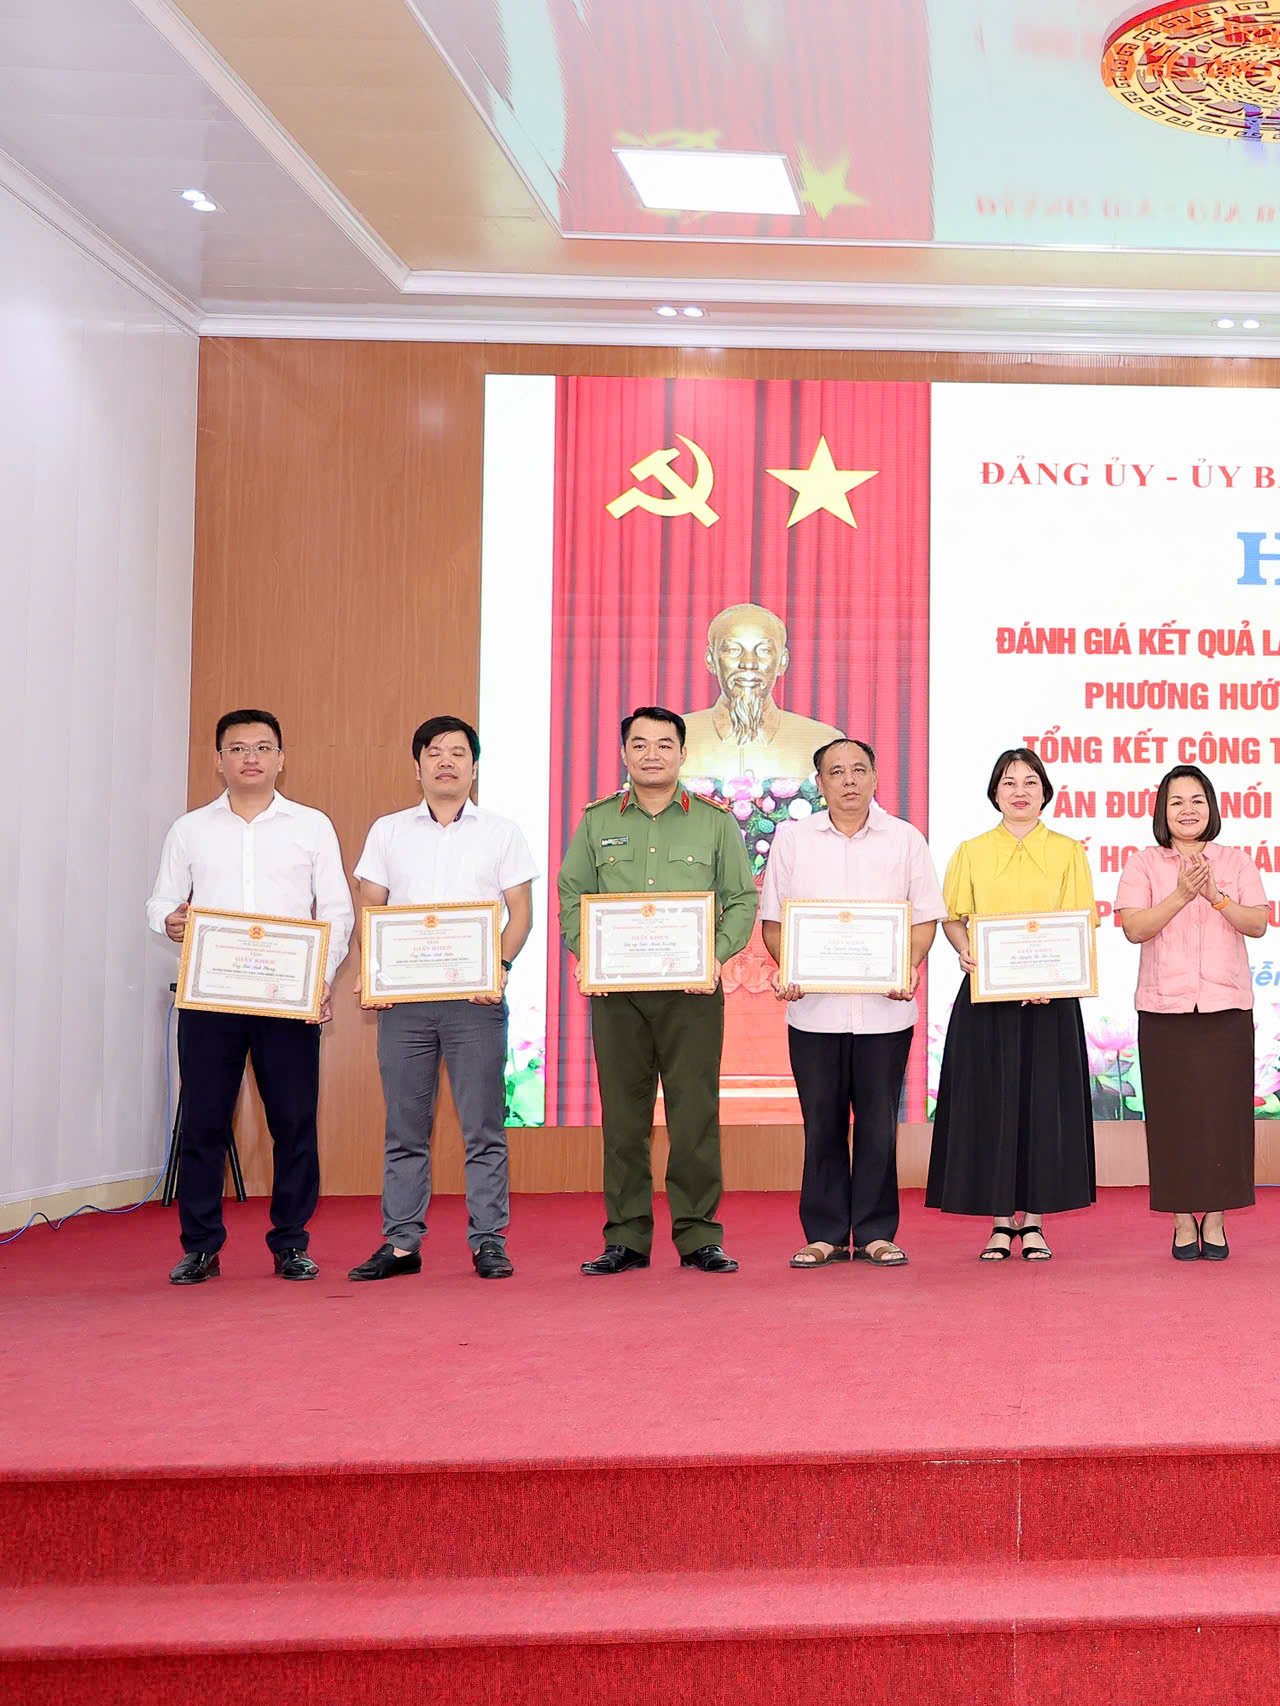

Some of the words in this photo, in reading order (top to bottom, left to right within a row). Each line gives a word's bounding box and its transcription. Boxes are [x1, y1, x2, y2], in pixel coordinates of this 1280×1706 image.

[980, 455, 1089, 487] ĐẢNG
[1104, 457, 1155, 488] ỦY
[1191, 458, 1243, 489] ỦY
[996, 621, 1076, 654] ĐÁNH
[1084, 622, 1132, 655] GIÁ
[1139, 620, 1190, 655] KẾT
[1198, 620, 1255, 658] QUẢ
[1085, 680, 1209, 710] PHƯƠNG
[1023, 725, 1102, 764] TỔNG
[1113, 728, 1168, 764] KẾT
[1178, 731, 1260, 765] CÔNG
[1053, 785, 1097, 818] ÁN
[1221, 782, 1272, 819] NỐI
